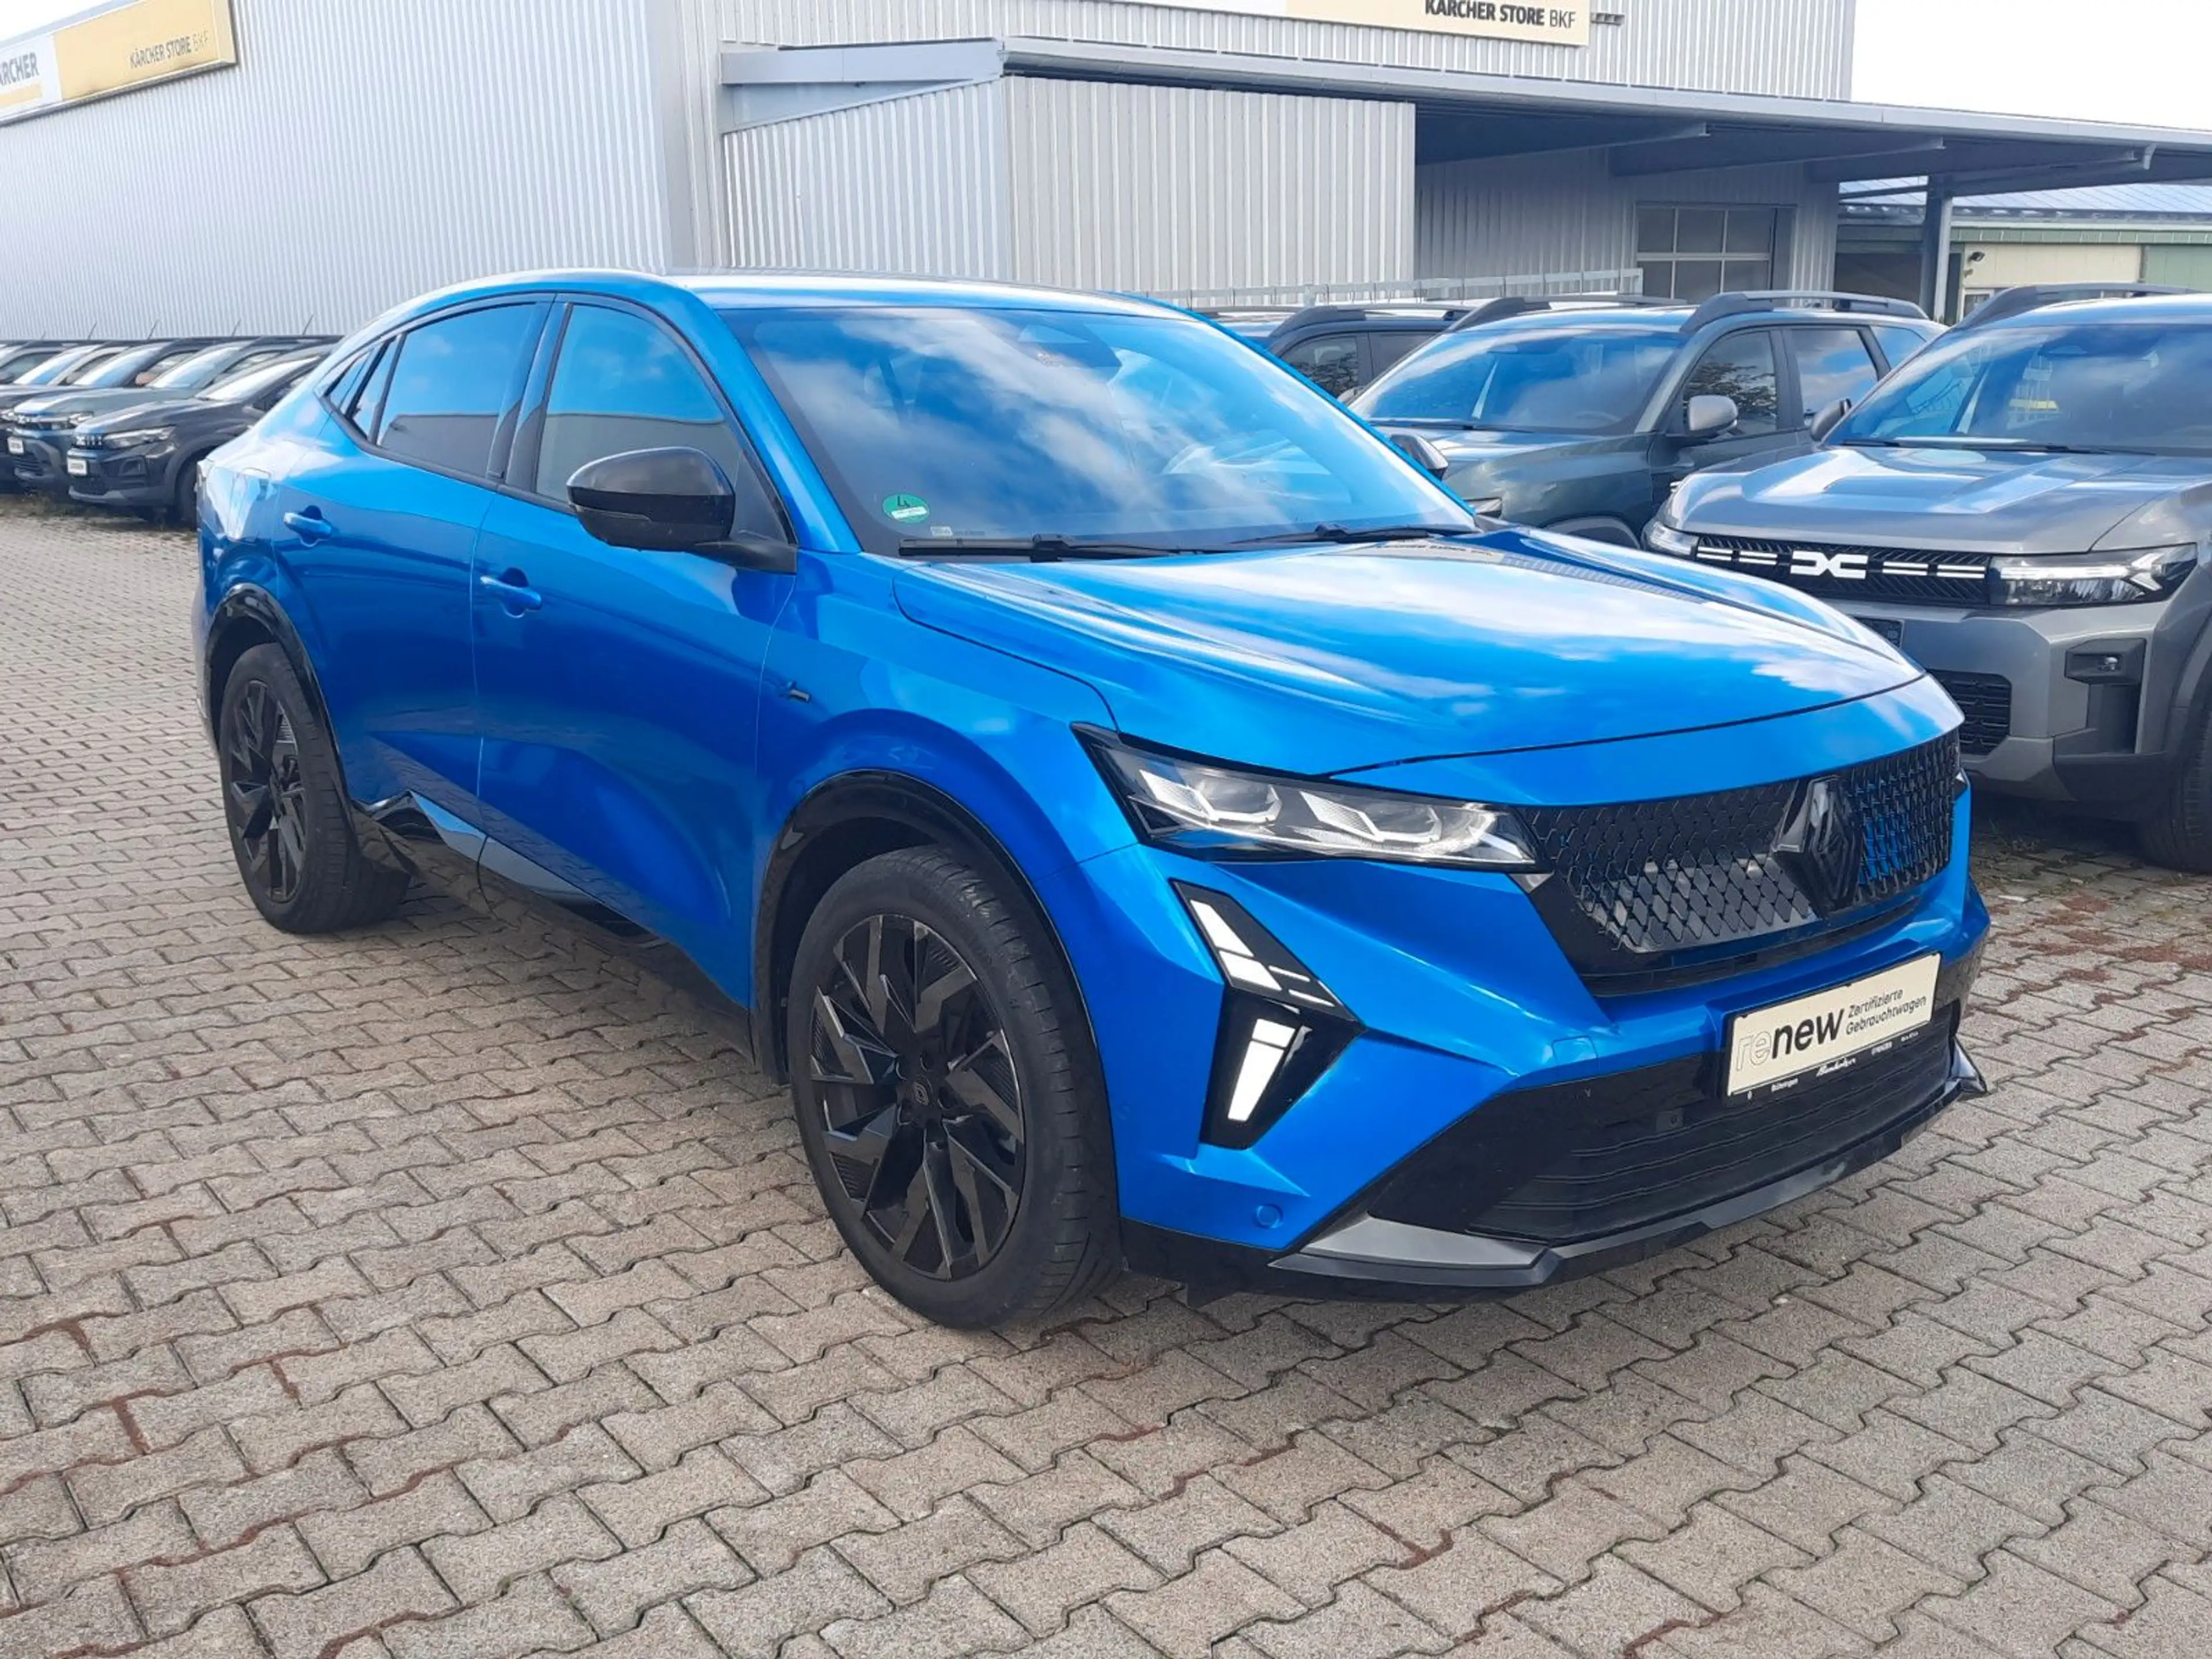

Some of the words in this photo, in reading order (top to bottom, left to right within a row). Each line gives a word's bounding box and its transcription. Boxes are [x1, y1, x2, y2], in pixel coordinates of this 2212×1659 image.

[1499, 4, 1545, 25] STORE
[1549, 9, 1576, 28] BKF
[166, 36, 191, 59] STORE
[1846, 995, 1927, 1035] Gebrauchtwagen
[1848, 989, 1904, 1018] Zertifizierte
[1736, 1009, 1845, 1071] renew
